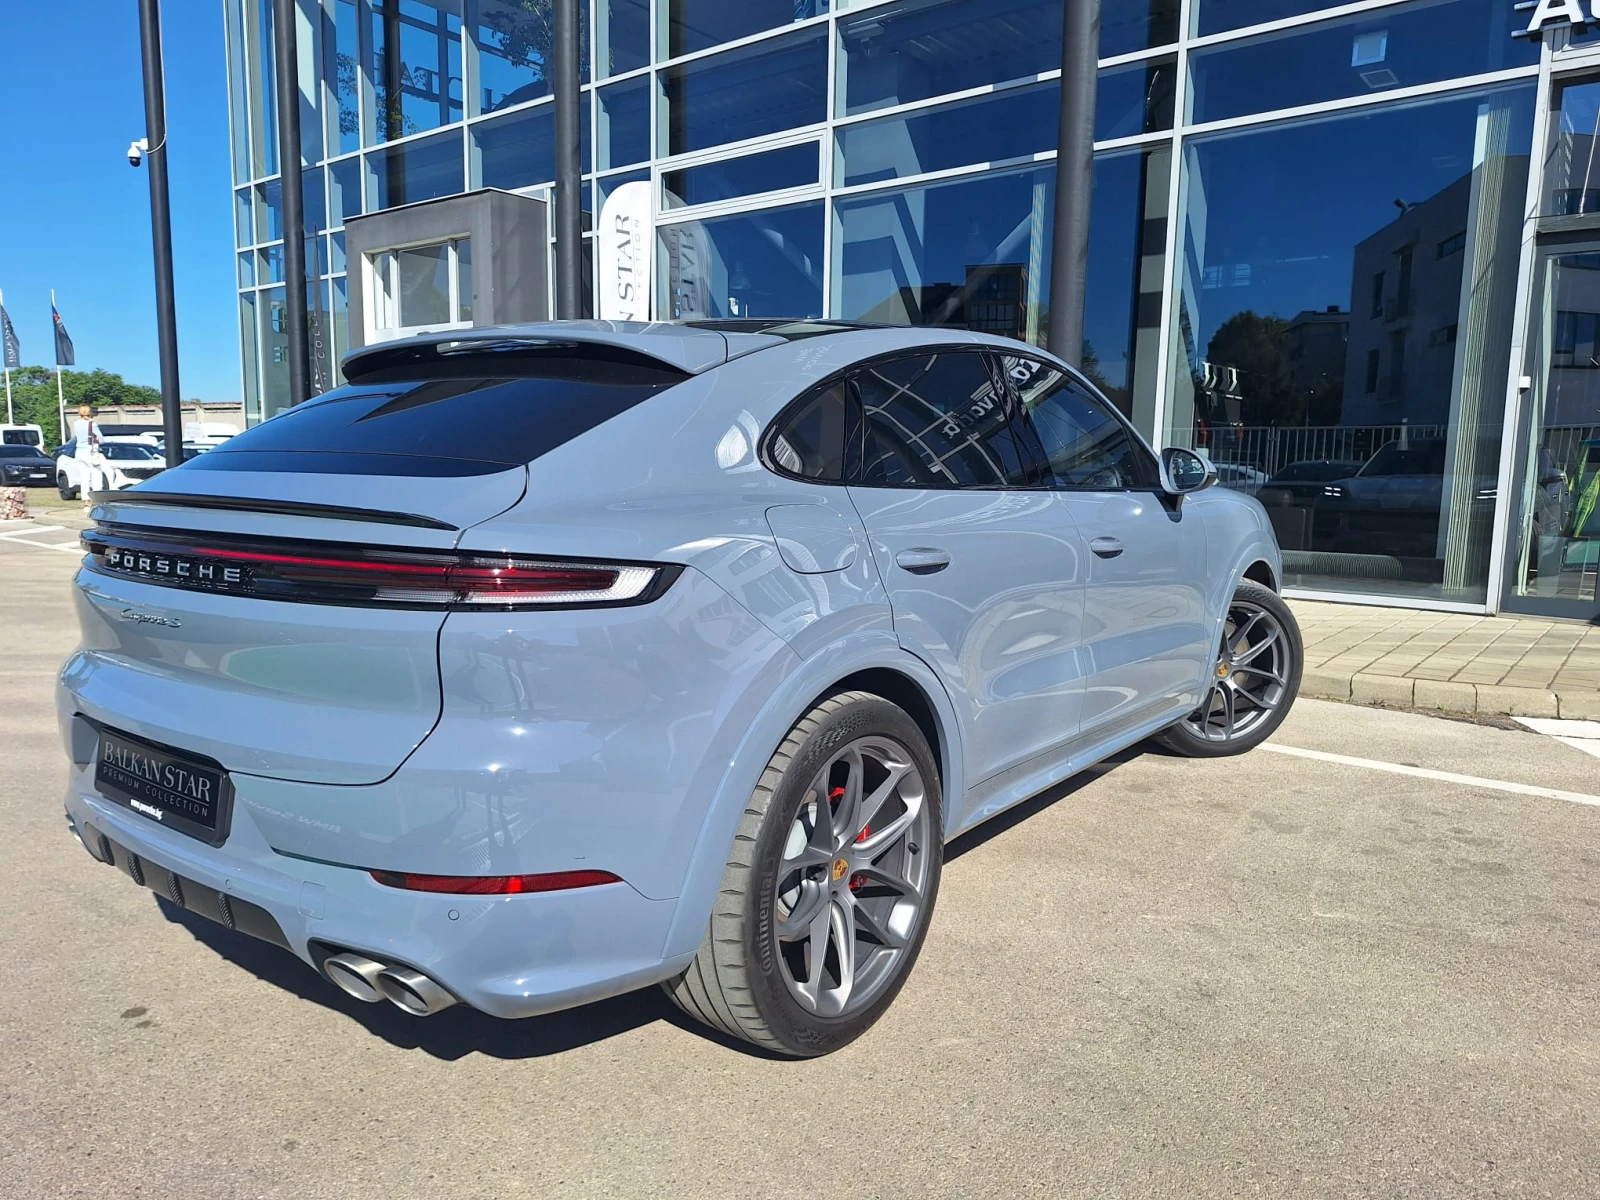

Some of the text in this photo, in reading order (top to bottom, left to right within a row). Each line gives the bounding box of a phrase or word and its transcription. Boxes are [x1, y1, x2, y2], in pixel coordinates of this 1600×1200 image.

[615, 213, 635, 302] STAR
[110, 553, 241, 583] PORSCHE
[168, 617, 182, 628] S
[103, 741, 211, 802] BALKAN STAR
[103, 766, 140, 789] PREMIUM
[145, 784, 208, 818] COLLECTION
[758, 871, 774, 976] Continental
